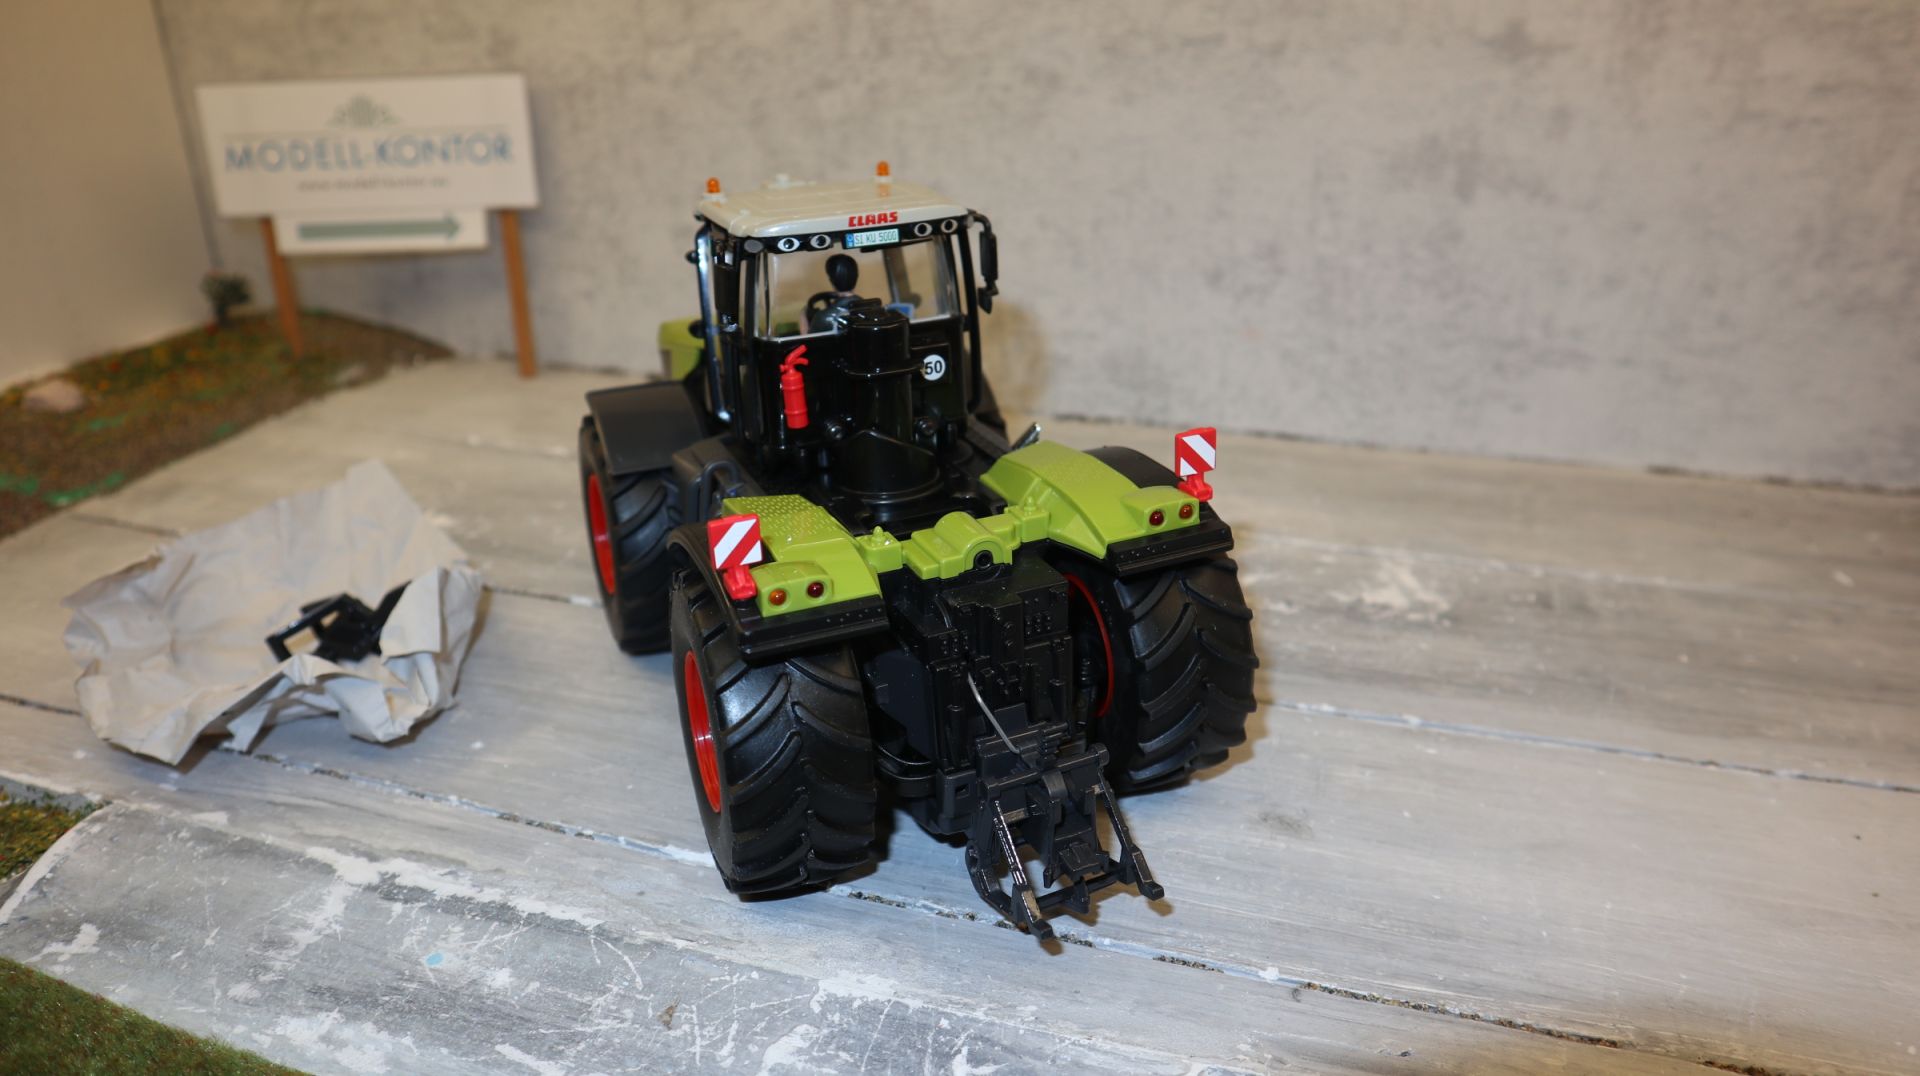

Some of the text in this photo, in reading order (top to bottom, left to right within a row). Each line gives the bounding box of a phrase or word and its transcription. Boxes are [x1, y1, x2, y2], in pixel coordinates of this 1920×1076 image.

[224, 131, 512, 173] MODELL-KONTOR
[848, 211, 898, 227] CLAAS
[878, 230, 897, 242] 5000
[924, 360, 943, 375] 50
